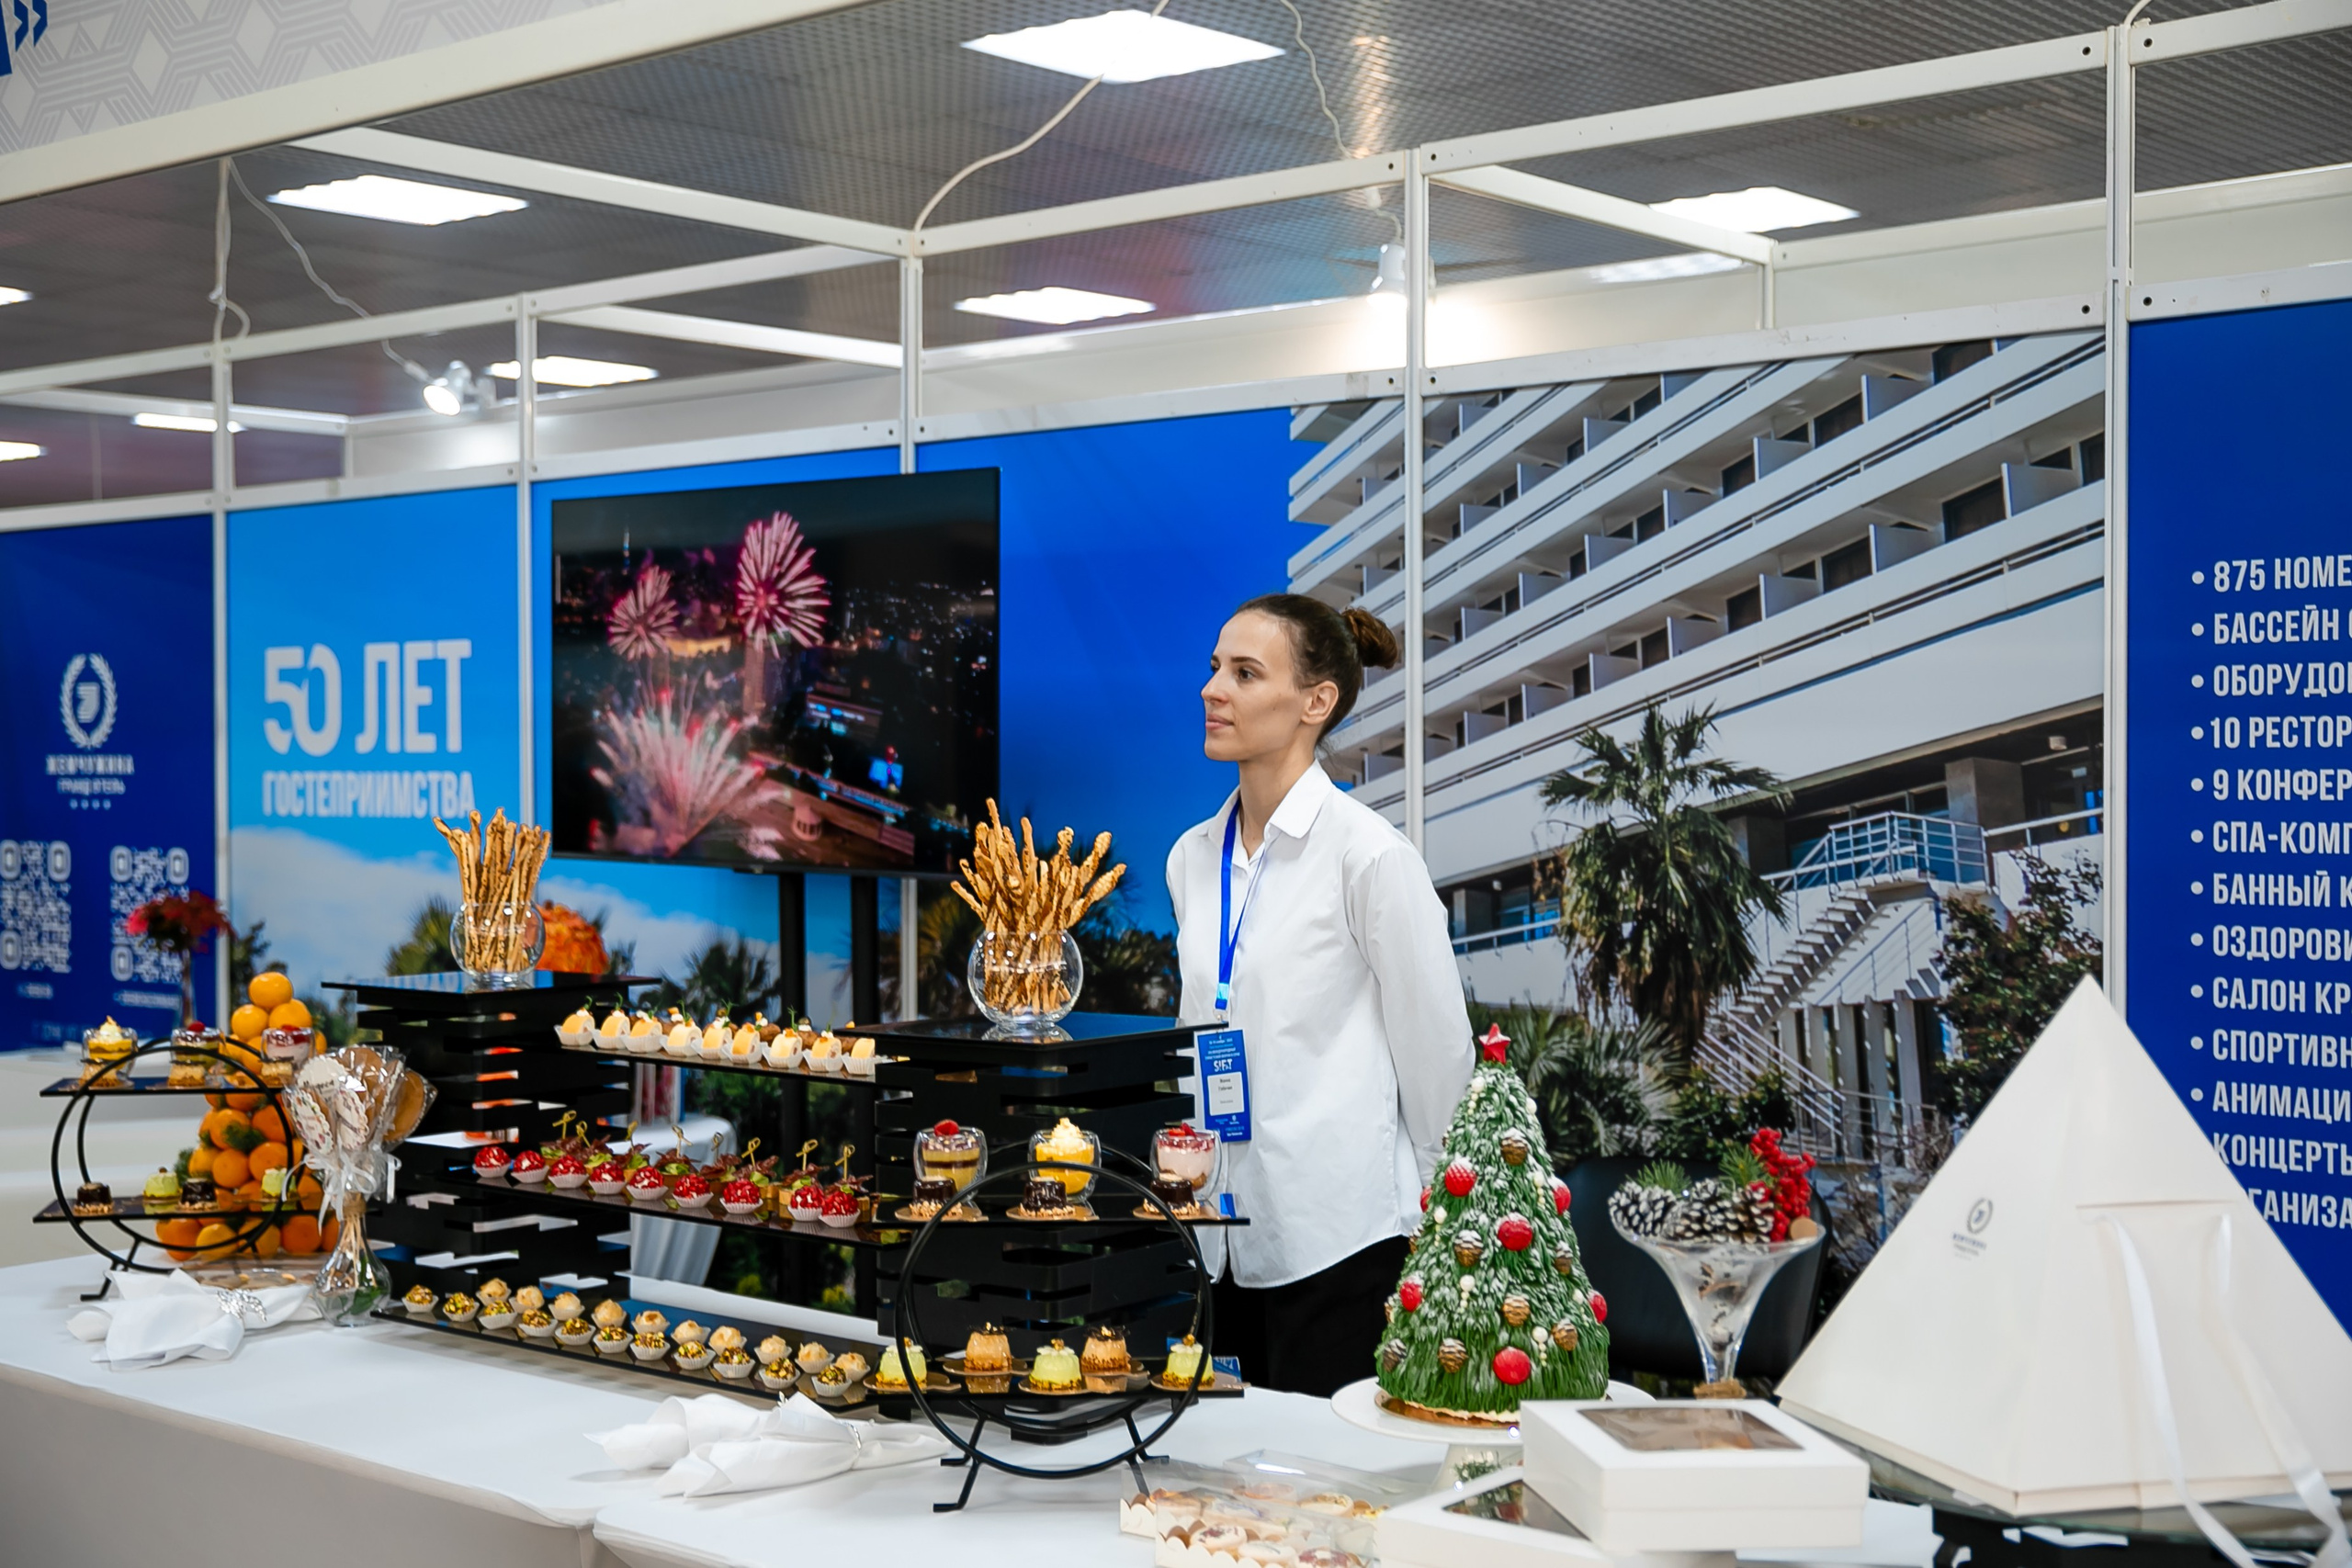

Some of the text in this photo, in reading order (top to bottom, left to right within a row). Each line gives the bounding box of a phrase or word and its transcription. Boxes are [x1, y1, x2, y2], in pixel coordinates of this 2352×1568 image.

[2214, 555, 2352, 592] 875 НОМЕ
[2215, 604, 2338, 644] БАССЕЙН
[264, 637, 472, 758] 50 ЛЕТ
[2214, 662, 2352, 697] ОБОРУДО
[2211, 716, 2352, 748] 10 РЕСТОР
[262, 769, 475, 820] ГОСТЕПРИИМСТВА
[2213, 769, 2352, 800] 9 КОНФЕР
[2214, 871, 2330, 907] БАННЫЙ
[2213, 977, 2352, 1015] САЛОН КР
[2213, 1029, 2352, 1067] СПОРТИВН
[2213, 1081, 2350, 1123] АНИМАЦИ
